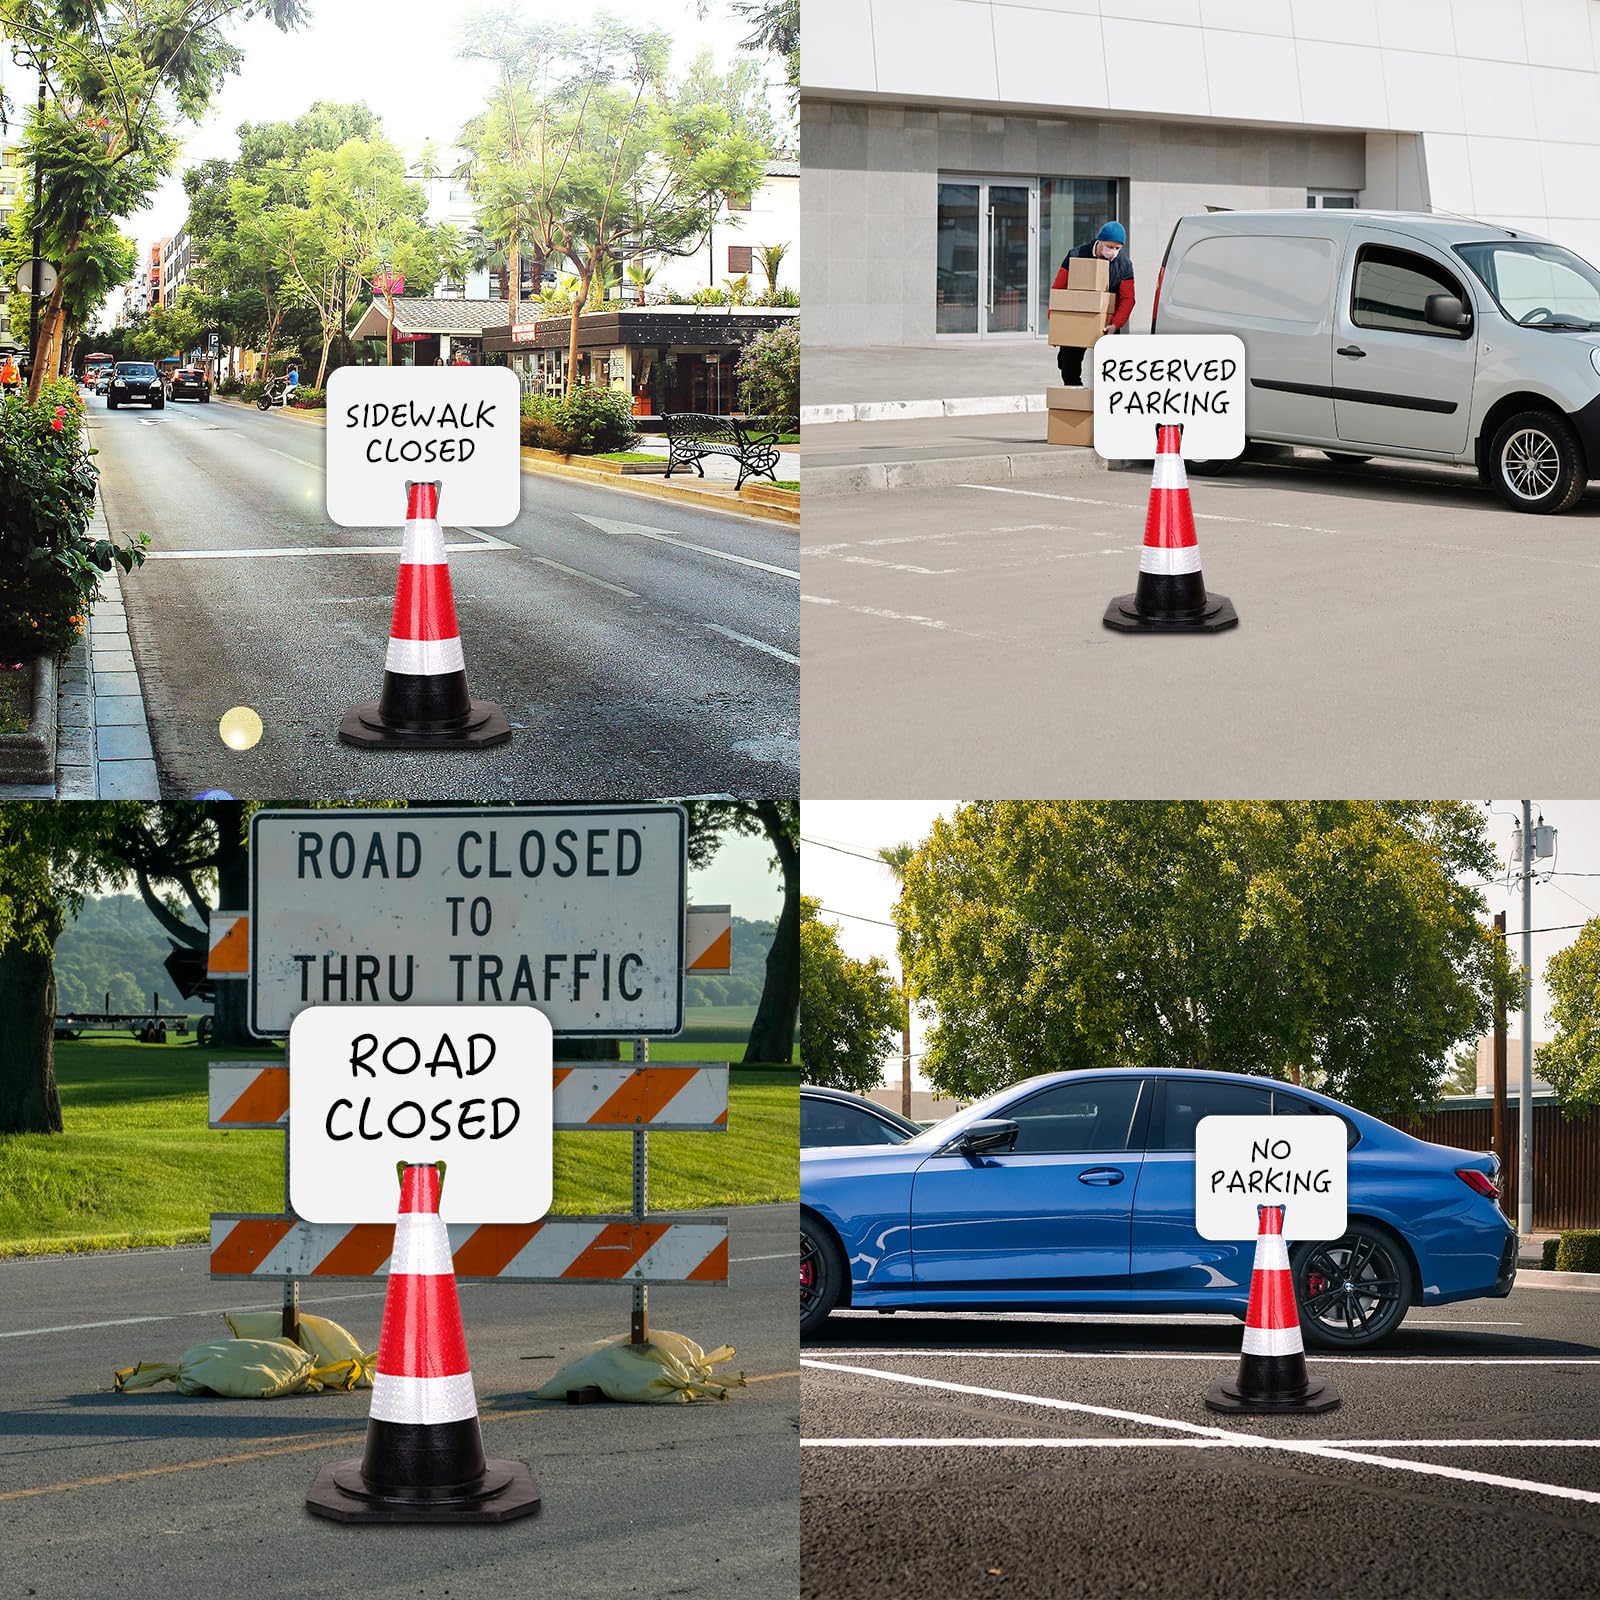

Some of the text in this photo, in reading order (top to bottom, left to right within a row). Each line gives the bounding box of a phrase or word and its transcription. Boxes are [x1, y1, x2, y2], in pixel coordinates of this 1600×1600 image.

[211, 335, 219, 345] P
[1102, 359, 1236, 382] RESERVED
[346, 400, 495, 429] SIDEWALK
[1110, 388, 1230, 416] PARKING
[367, 438, 475, 463] CLOSED
[298, 829, 642, 879] ROAD CLOSED
[446, 897, 492, 937] TO
[294, 953, 643, 1002] THRU TRAFFIC
[350, 1033, 497, 1079] ROAD
[326, 1097, 520, 1142] CLOSED
[1252, 1138, 1291, 1163] NO
[1212, 1167, 1332, 1195] PARKING
